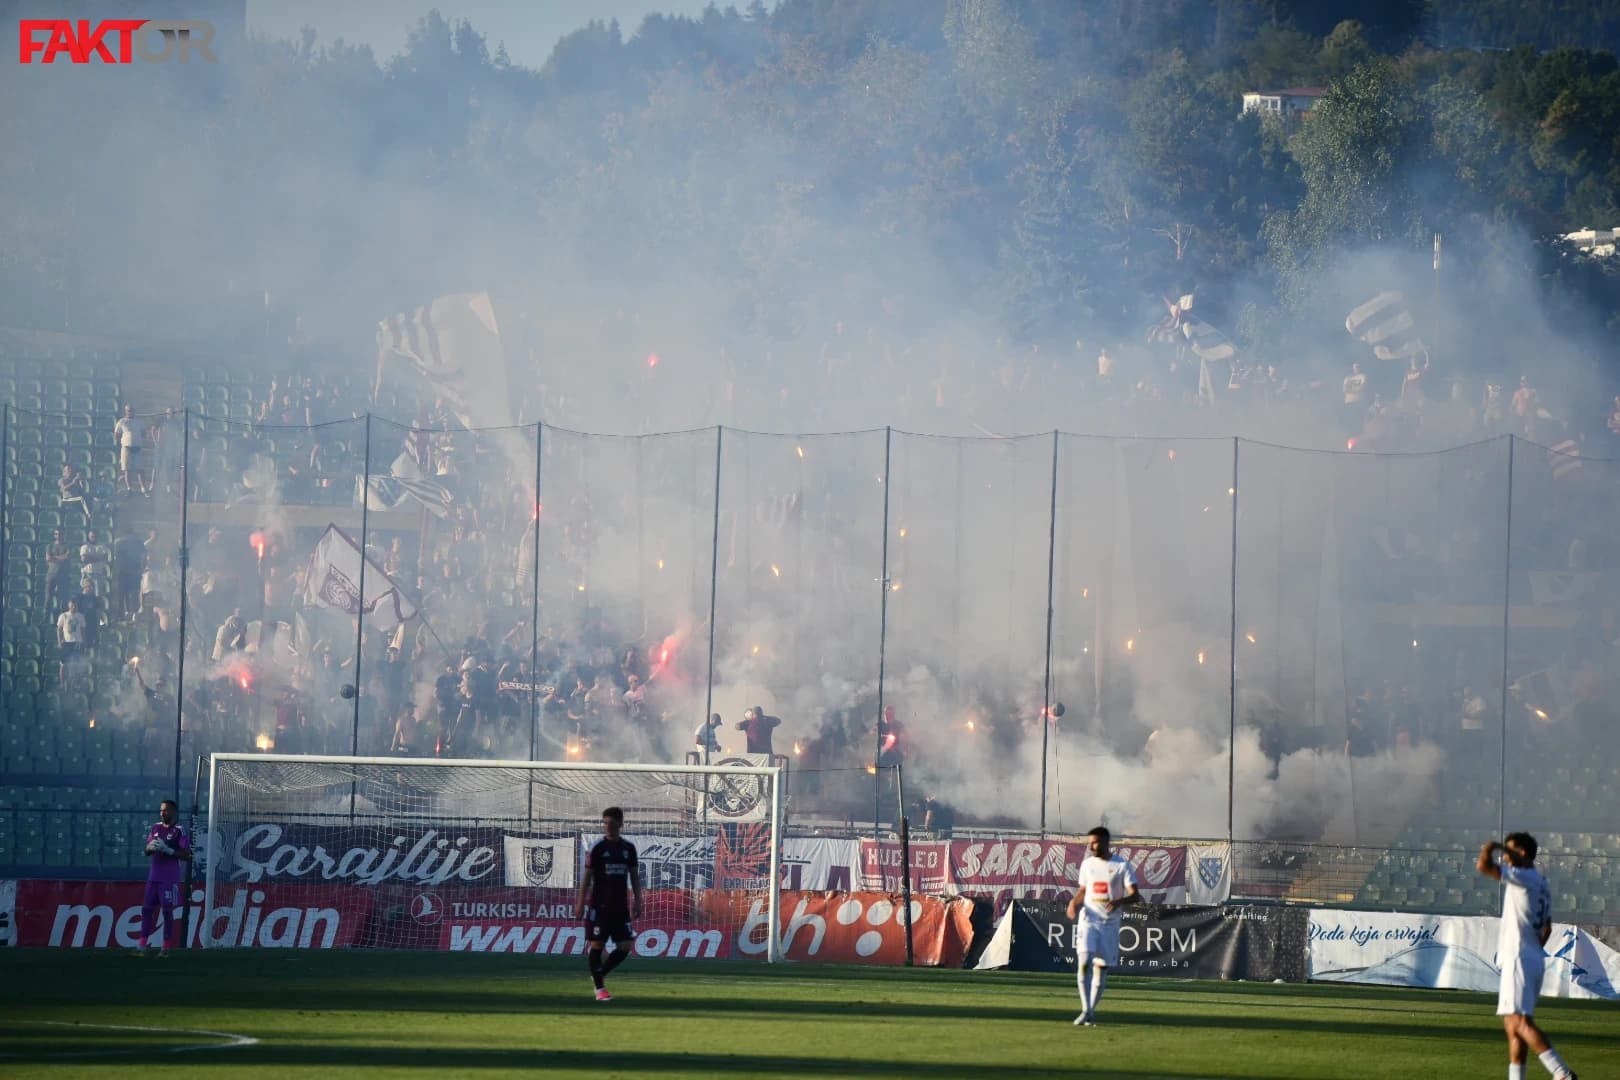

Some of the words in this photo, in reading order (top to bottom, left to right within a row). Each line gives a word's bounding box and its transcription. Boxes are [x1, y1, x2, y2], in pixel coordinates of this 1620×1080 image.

[958, 842, 1171, 885] SARAVO
[453, 902, 530, 918] TURKISH
[1048, 923, 1196, 953] REORM
[1350, 925, 1379, 946] koja
[1385, 925, 1439, 946] osvaja!
